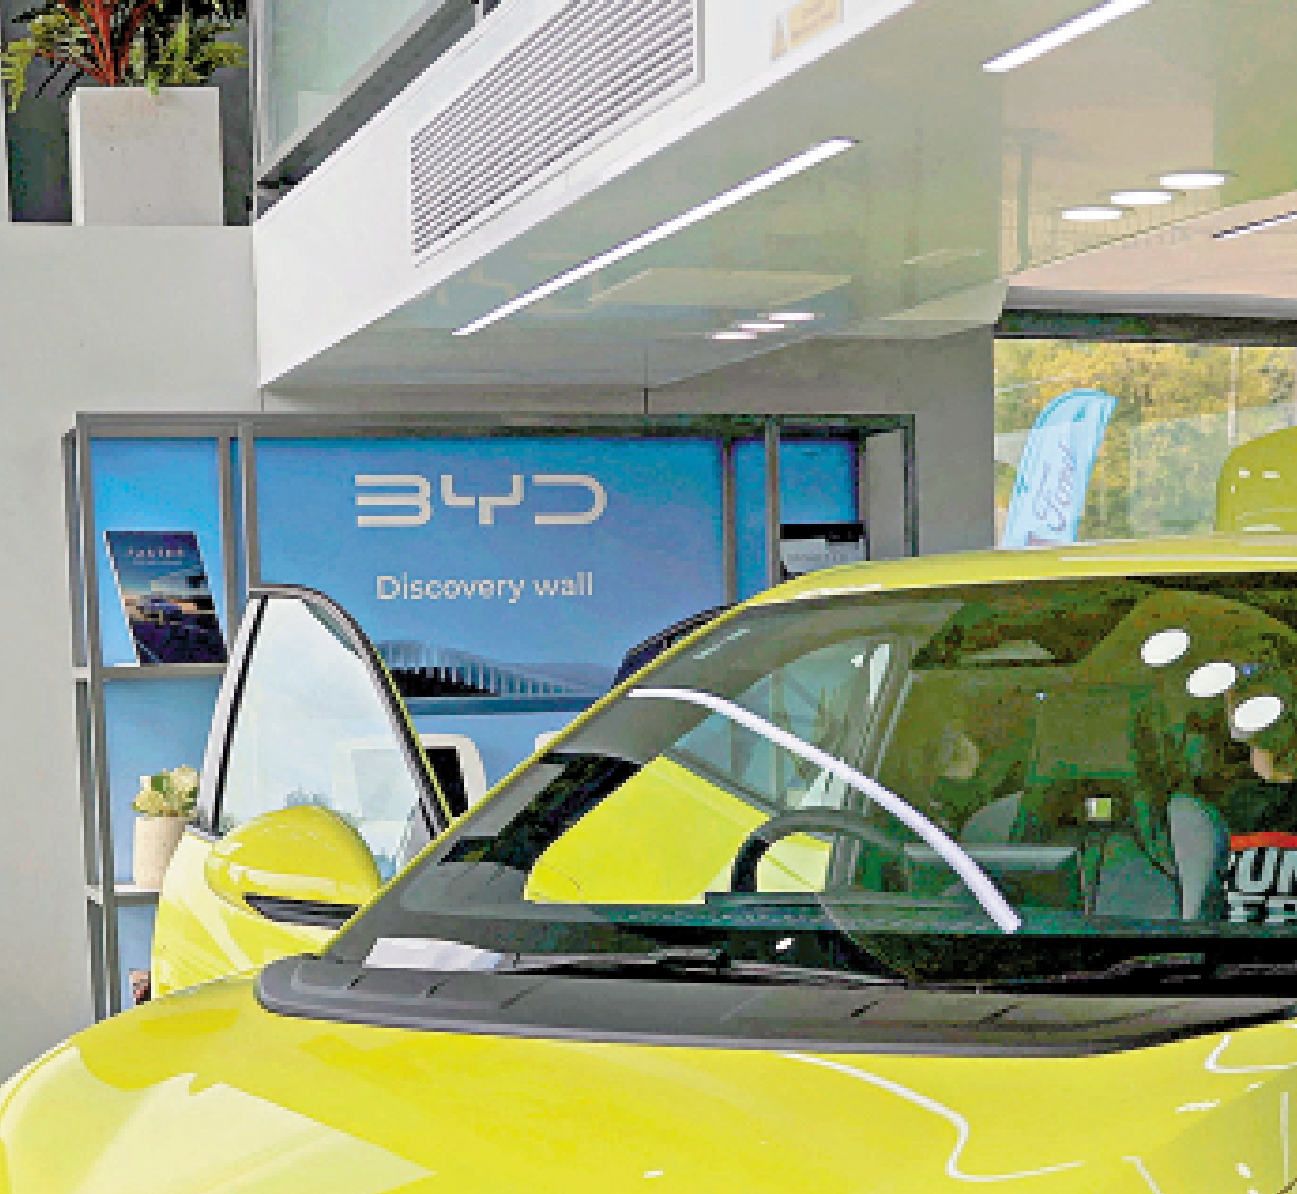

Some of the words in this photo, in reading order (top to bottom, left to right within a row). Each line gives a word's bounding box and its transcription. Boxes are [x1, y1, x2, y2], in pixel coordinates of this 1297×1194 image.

[354, 474, 608, 527] BYD
[376, 571, 525, 604] Discovery
[532, 571, 594, 597] wall
